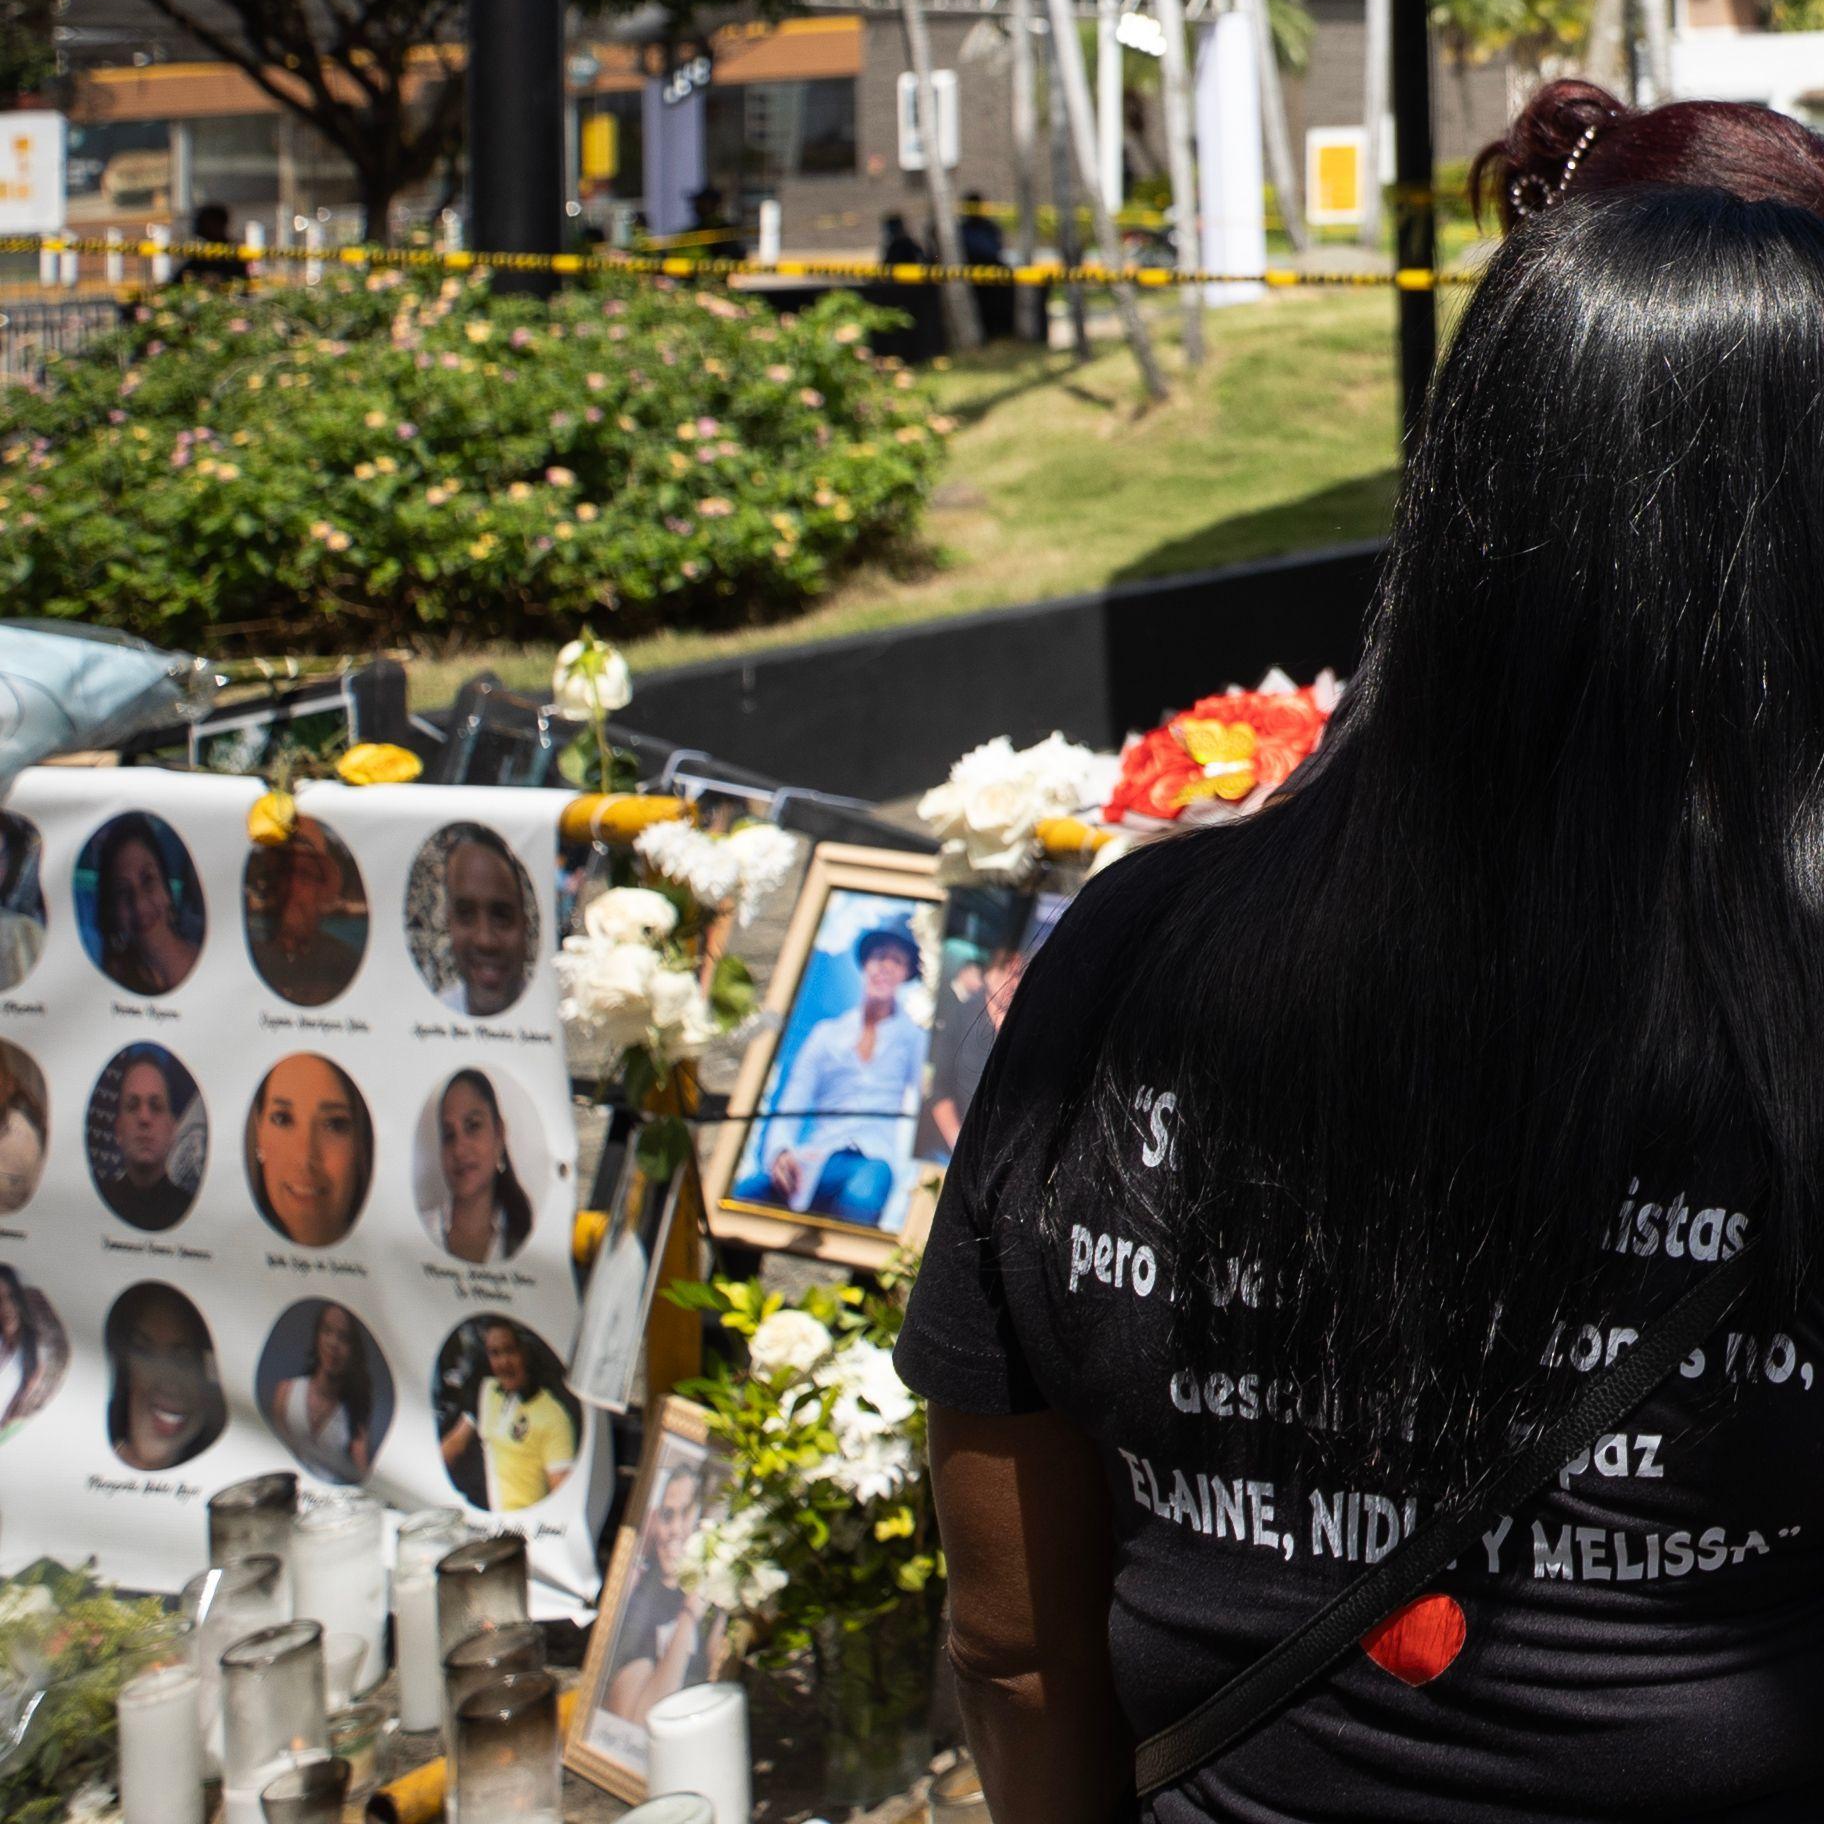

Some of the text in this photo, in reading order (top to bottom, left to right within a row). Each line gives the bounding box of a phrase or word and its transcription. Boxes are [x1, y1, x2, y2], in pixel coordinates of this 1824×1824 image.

[1069, 1223, 1157, 1298] pero
[1118, 1447, 1295, 1562] ELAINE,
[1482, 1514, 1514, 1574] Y
